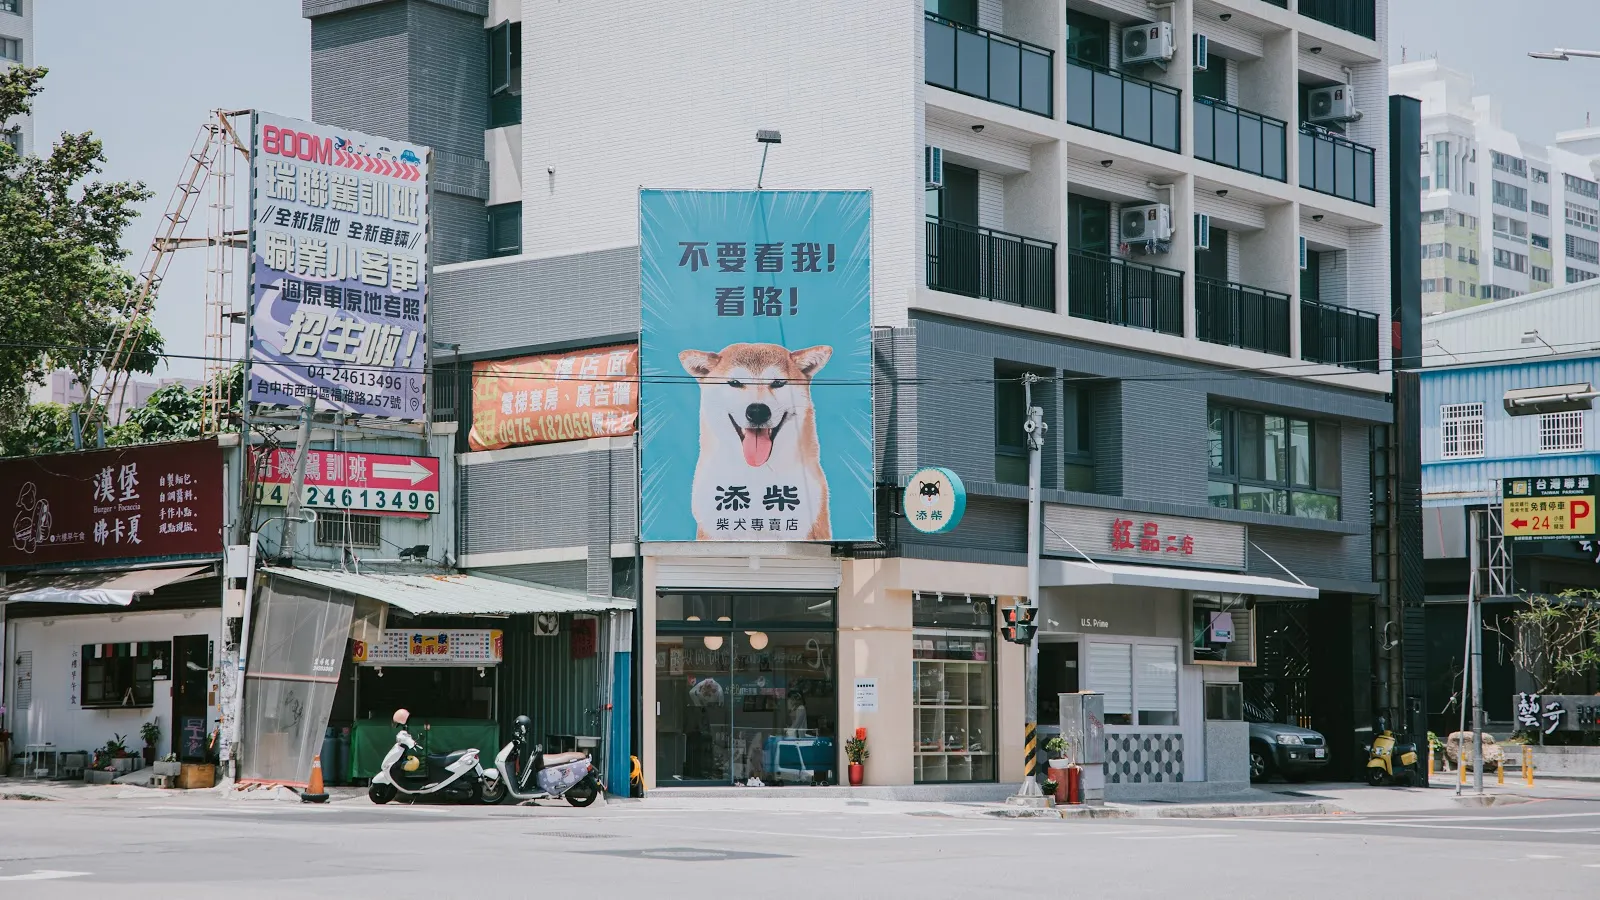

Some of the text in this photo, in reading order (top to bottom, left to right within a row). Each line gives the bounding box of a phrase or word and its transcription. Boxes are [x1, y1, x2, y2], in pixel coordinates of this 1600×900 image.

[265, 160, 419, 225] 瑞聯駕訓班
[274, 207, 410, 248] 全新場地 全新車輛
[264, 231, 418, 292] 職業小客車
[678, 241, 836, 273] 不要看我!
[260, 278, 420, 322] 一週原車原地考照
[715, 286, 798, 317] 看路!
[281, 310, 418, 368] 招生啦!
[307, 365, 401, 389] 04-24613496
[257, 380, 402, 410] 台中市西屯區福雅路257號
[500, 411, 593, 444] 0975-182059
[93, 462, 140, 503] 漢堡
[93, 502, 141, 514] Burger Focaccia
[306, 486, 435, 512] 24613496
[714, 485, 801, 512] 添柴
[93, 514, 142, 546] 佛卡夏
[716, 518, 799, 532] 柴犬專賣店
[915, 510, 943, 521] 添柴
[1532, 516, 1550, 530] 24
[1570, 501, 1590, 529] P
[1081, 618, 1109, 628] U.S. Prime
